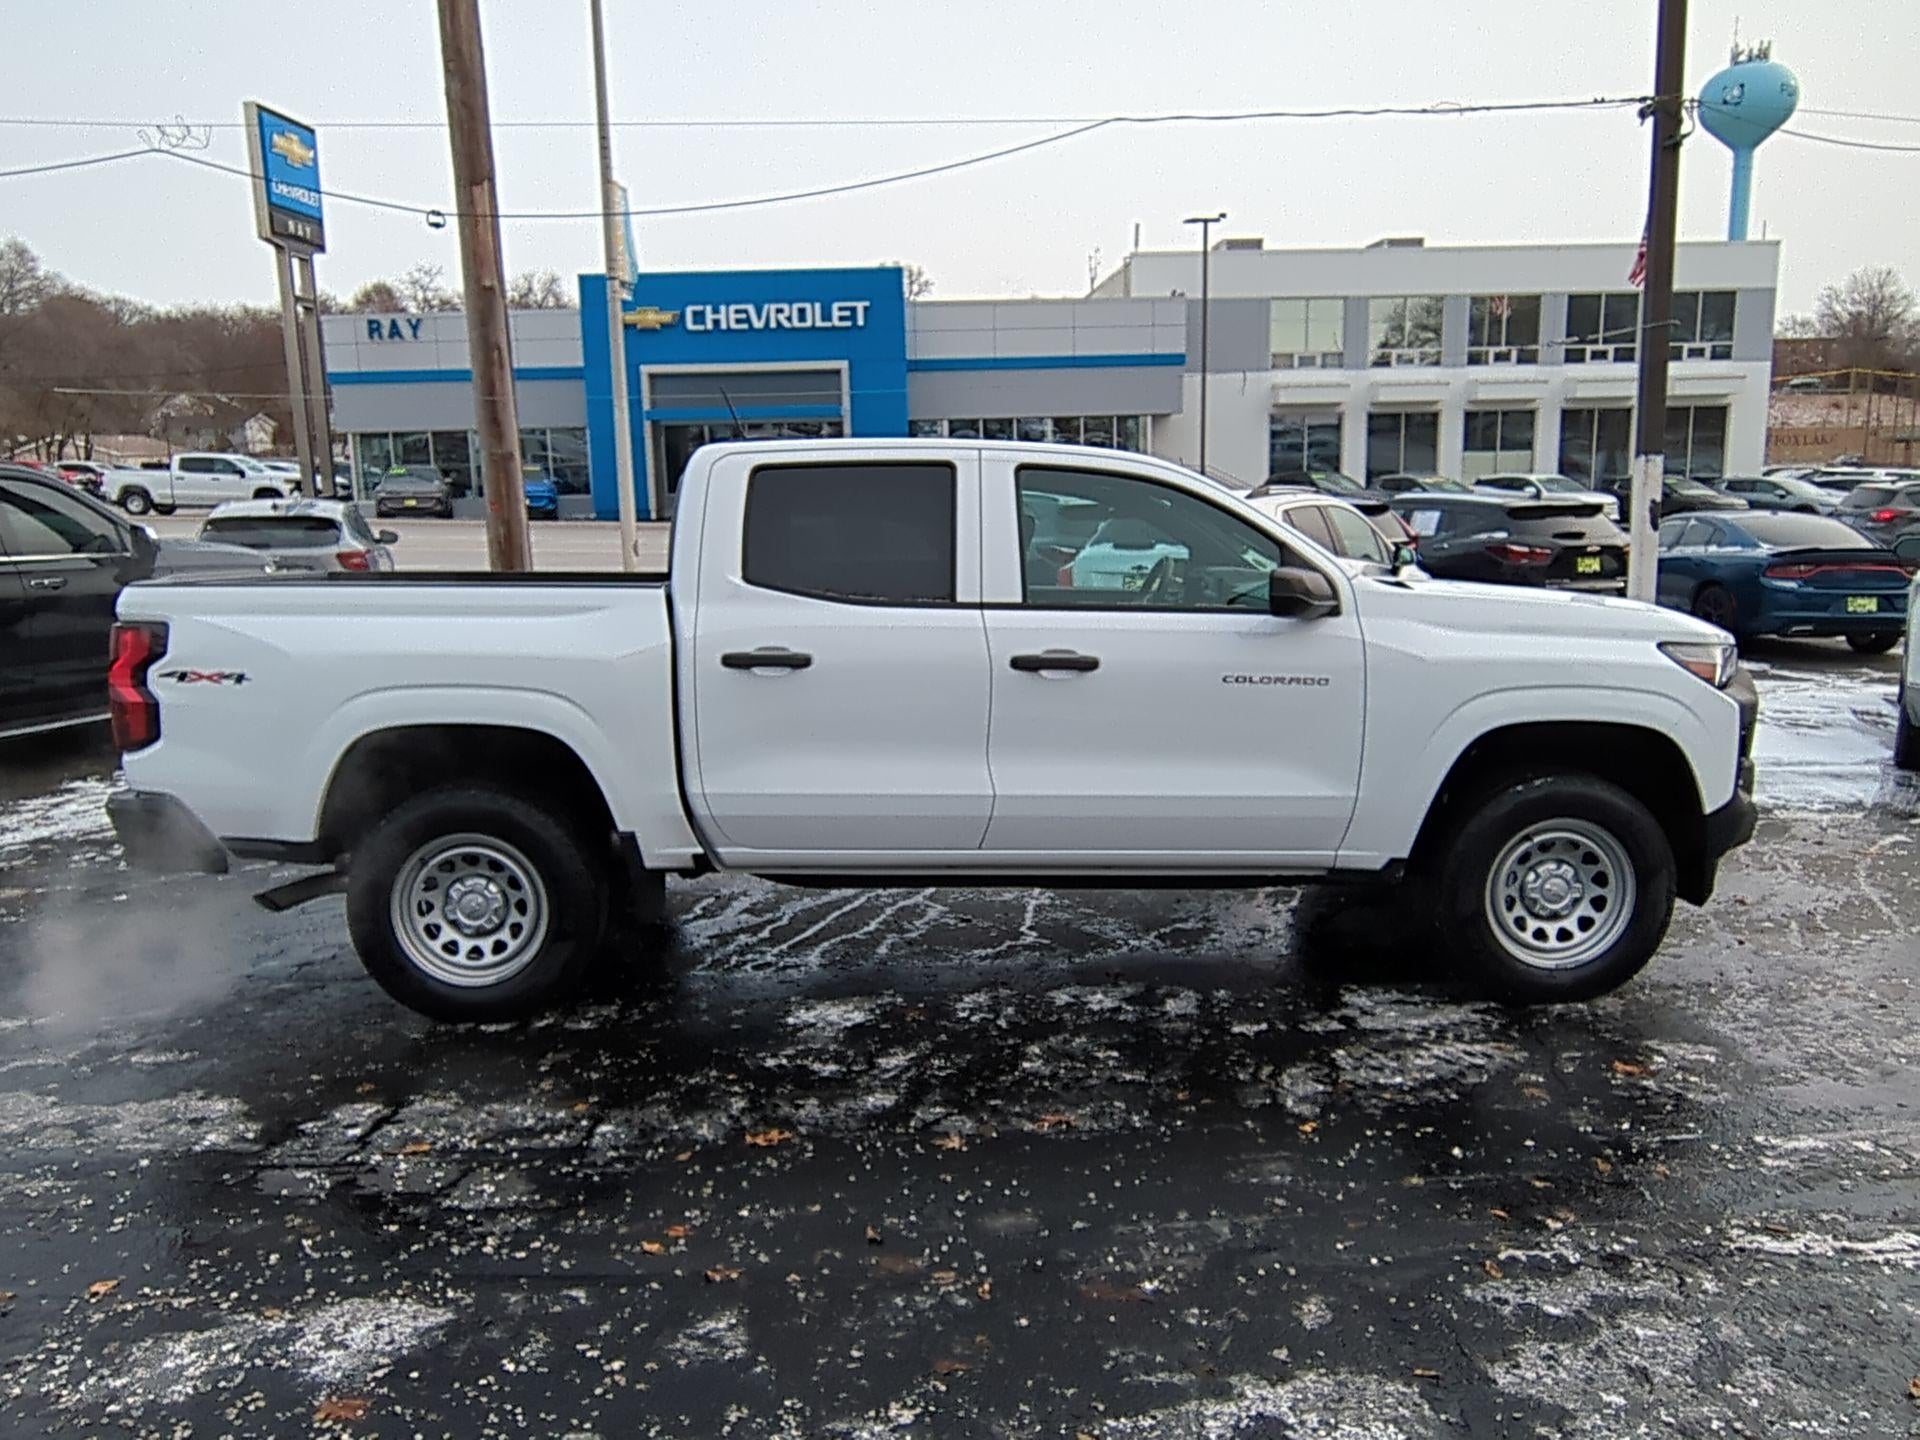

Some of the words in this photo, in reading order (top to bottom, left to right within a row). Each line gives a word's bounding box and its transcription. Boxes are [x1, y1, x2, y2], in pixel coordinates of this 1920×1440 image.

[685, 301, 871, 331] CHEVROLET
[367, 318, 423, 341] RAY
[1222, 675, 1330, 686] COLORADO
